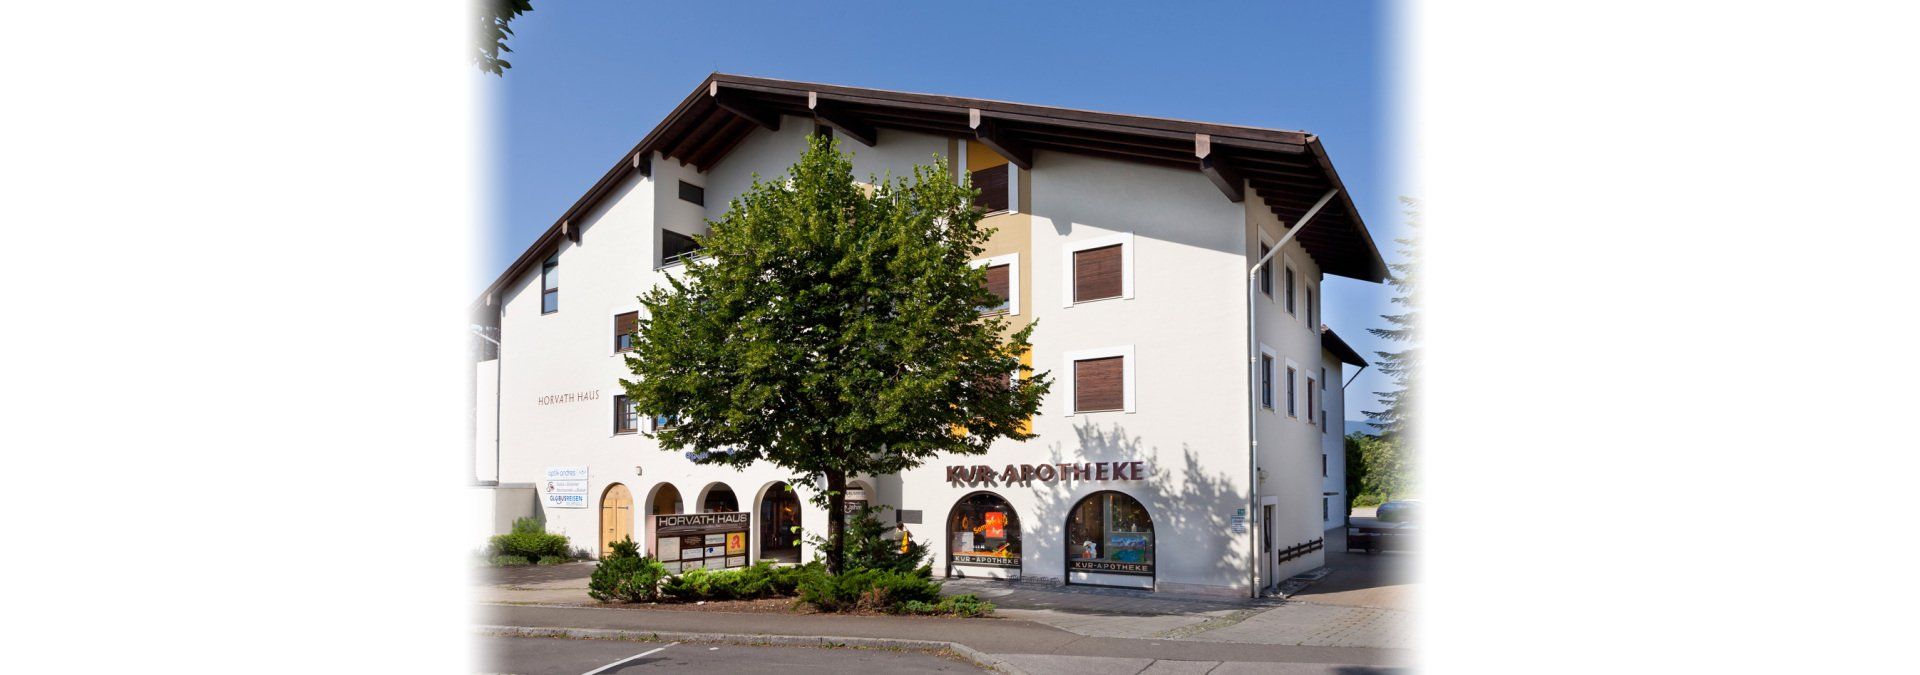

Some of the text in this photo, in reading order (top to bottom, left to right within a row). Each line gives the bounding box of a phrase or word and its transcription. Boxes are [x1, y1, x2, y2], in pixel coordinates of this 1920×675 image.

[538, 389, 599, 405] HORVATH HAUS
[549, 495, 583, 503] GLOBUSREISEN
[659, 514, 747, 526] HORVATH HAUS
[955, 556, 1019, 565] KUR-APOTHEKE
[1073, 562, 1148, 572] KUR-APOTHEKE
